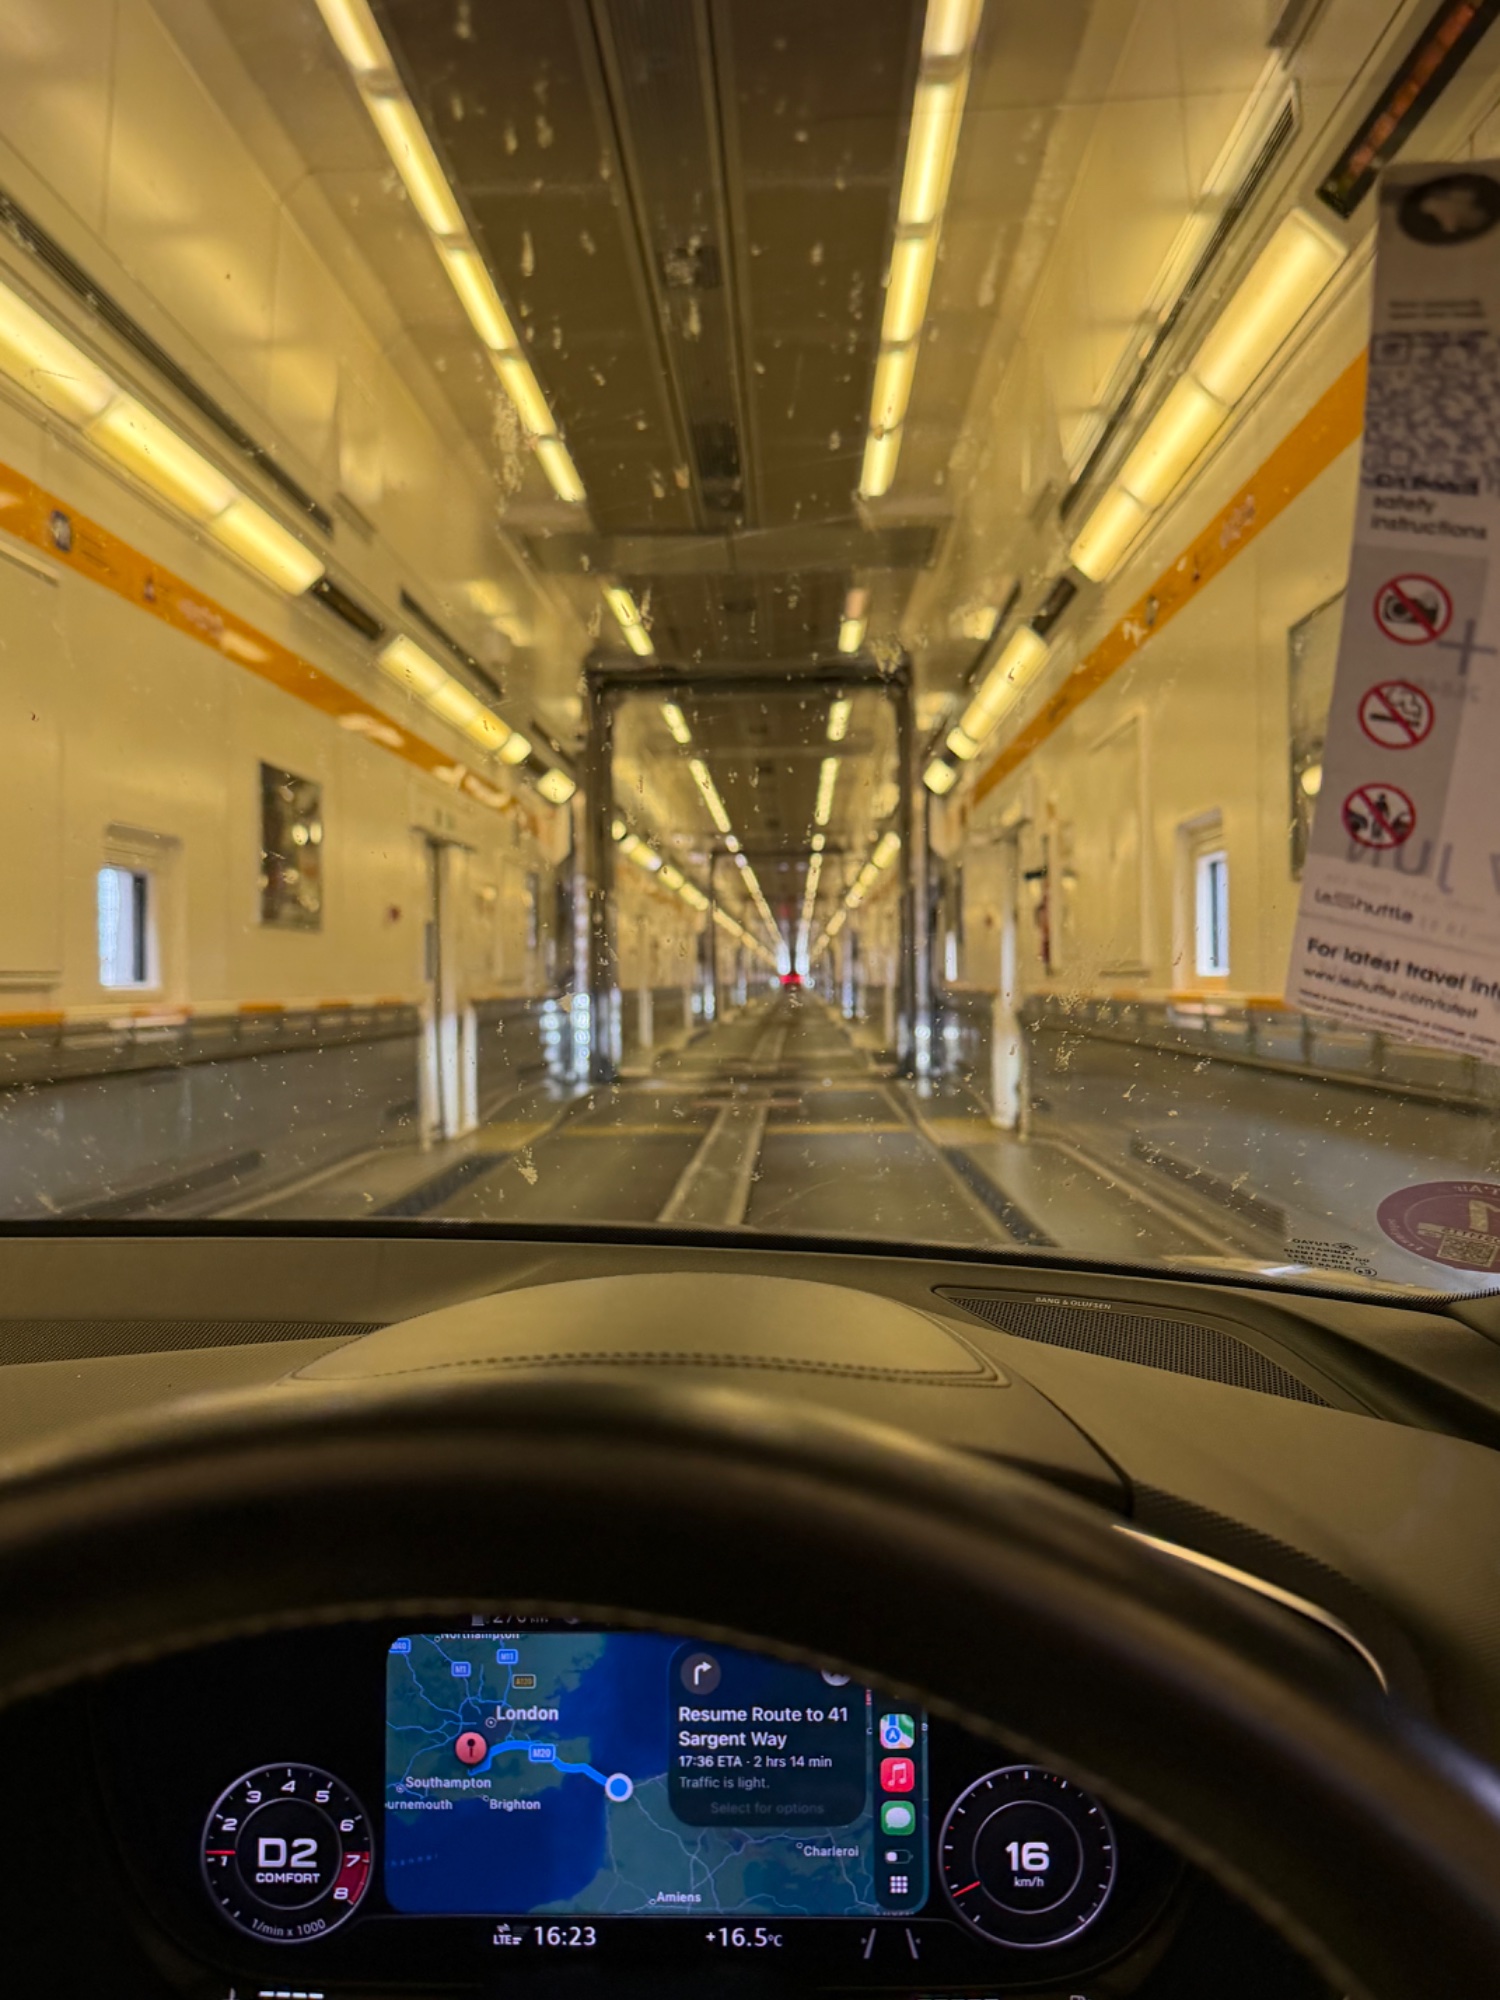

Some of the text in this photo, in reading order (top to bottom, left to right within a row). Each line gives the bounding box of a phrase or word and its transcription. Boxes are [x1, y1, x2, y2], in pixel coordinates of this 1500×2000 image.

[1307, 937, 1338, 958] For
[1344, 947, 1399, 972] latest
[1406, 962, 1467, 990] travel
[1070, 1300, 1111, 1310] OLUFSEN
[496, 1705, 559, 1721] London
[678, 1706, 848, 1722] Resume Route to 41
[678, 1731, 787, 1750] Sargent Way
[532, 1749, 550, 1758] M20
[678, 1755, 832, 1768] 17:36 ETA 2 hrs 14 min
[281, 1780, 296, 1793] 4
[405, 1776, 492, 1791] Southampton
[679, 1776, 770, 1791] Traffic is light.
[246, 1791, 262, 1803] 3
[315, 1790, 330, 1803] 5
[489, 1799, 541, 1812] Brighton
[710, 1802, 825, 1817] Select for options
[221, 1818, 238, 1831] 2
[340, 1819, 355, 1832] 6
[258, 1838, 318, 1868] D2
[803, 1845, 859, 1858] Charleroi
[1005, 1841, 1050, 1872] 16
[220, 1855, 228, 1867] 1
[346, 1854, 361, 1867] 7
[255, 1872, 321, 1884] COMFORT
[1014, 1876, 1045, 1888] km/h
[333, 1888, 349, 1900] 8
[656, 1891, 702, 1903] Amiens
[252, 1918, 326, 1937] 1/min x 1000
[493, 1934, 512, 1945] LTE
[534, 1926, 597, 1946] 16:23
